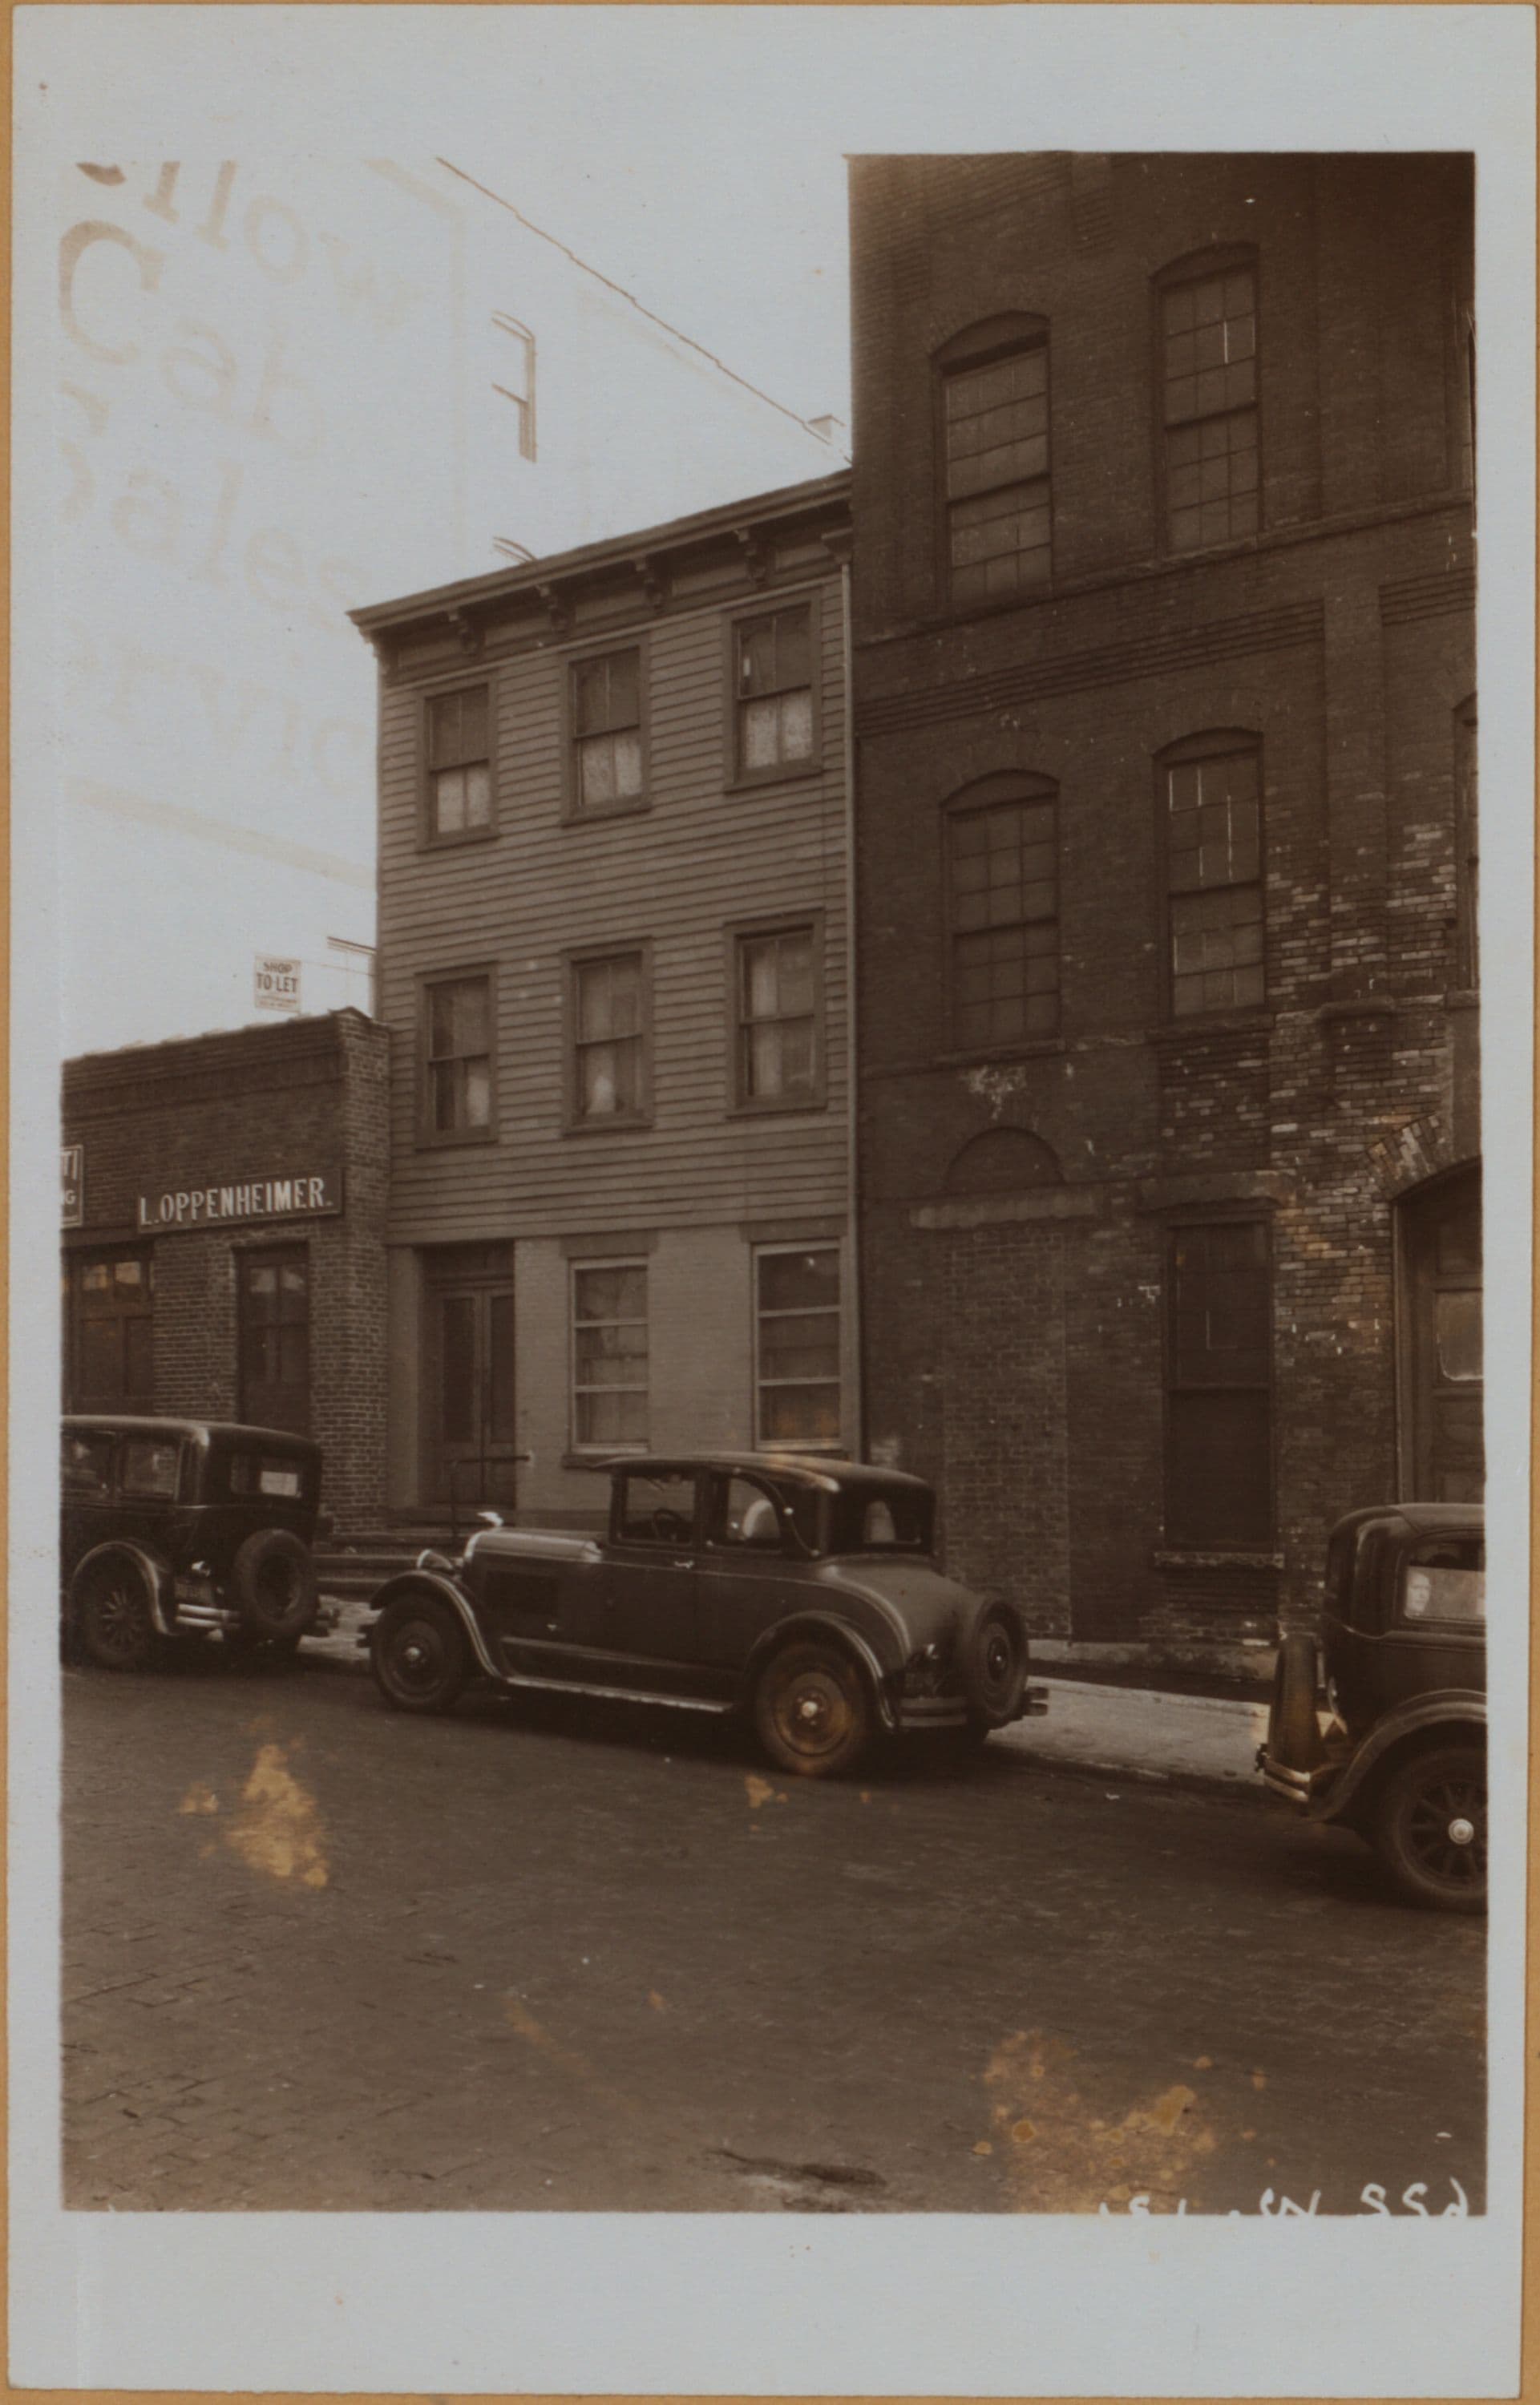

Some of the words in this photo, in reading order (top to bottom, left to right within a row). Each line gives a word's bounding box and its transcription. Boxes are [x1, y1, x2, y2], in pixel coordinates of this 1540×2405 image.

[59, 219, 327, 460] Cab
[257, 972, 273, 990] TO
[276, 976, 297, 993] LET
